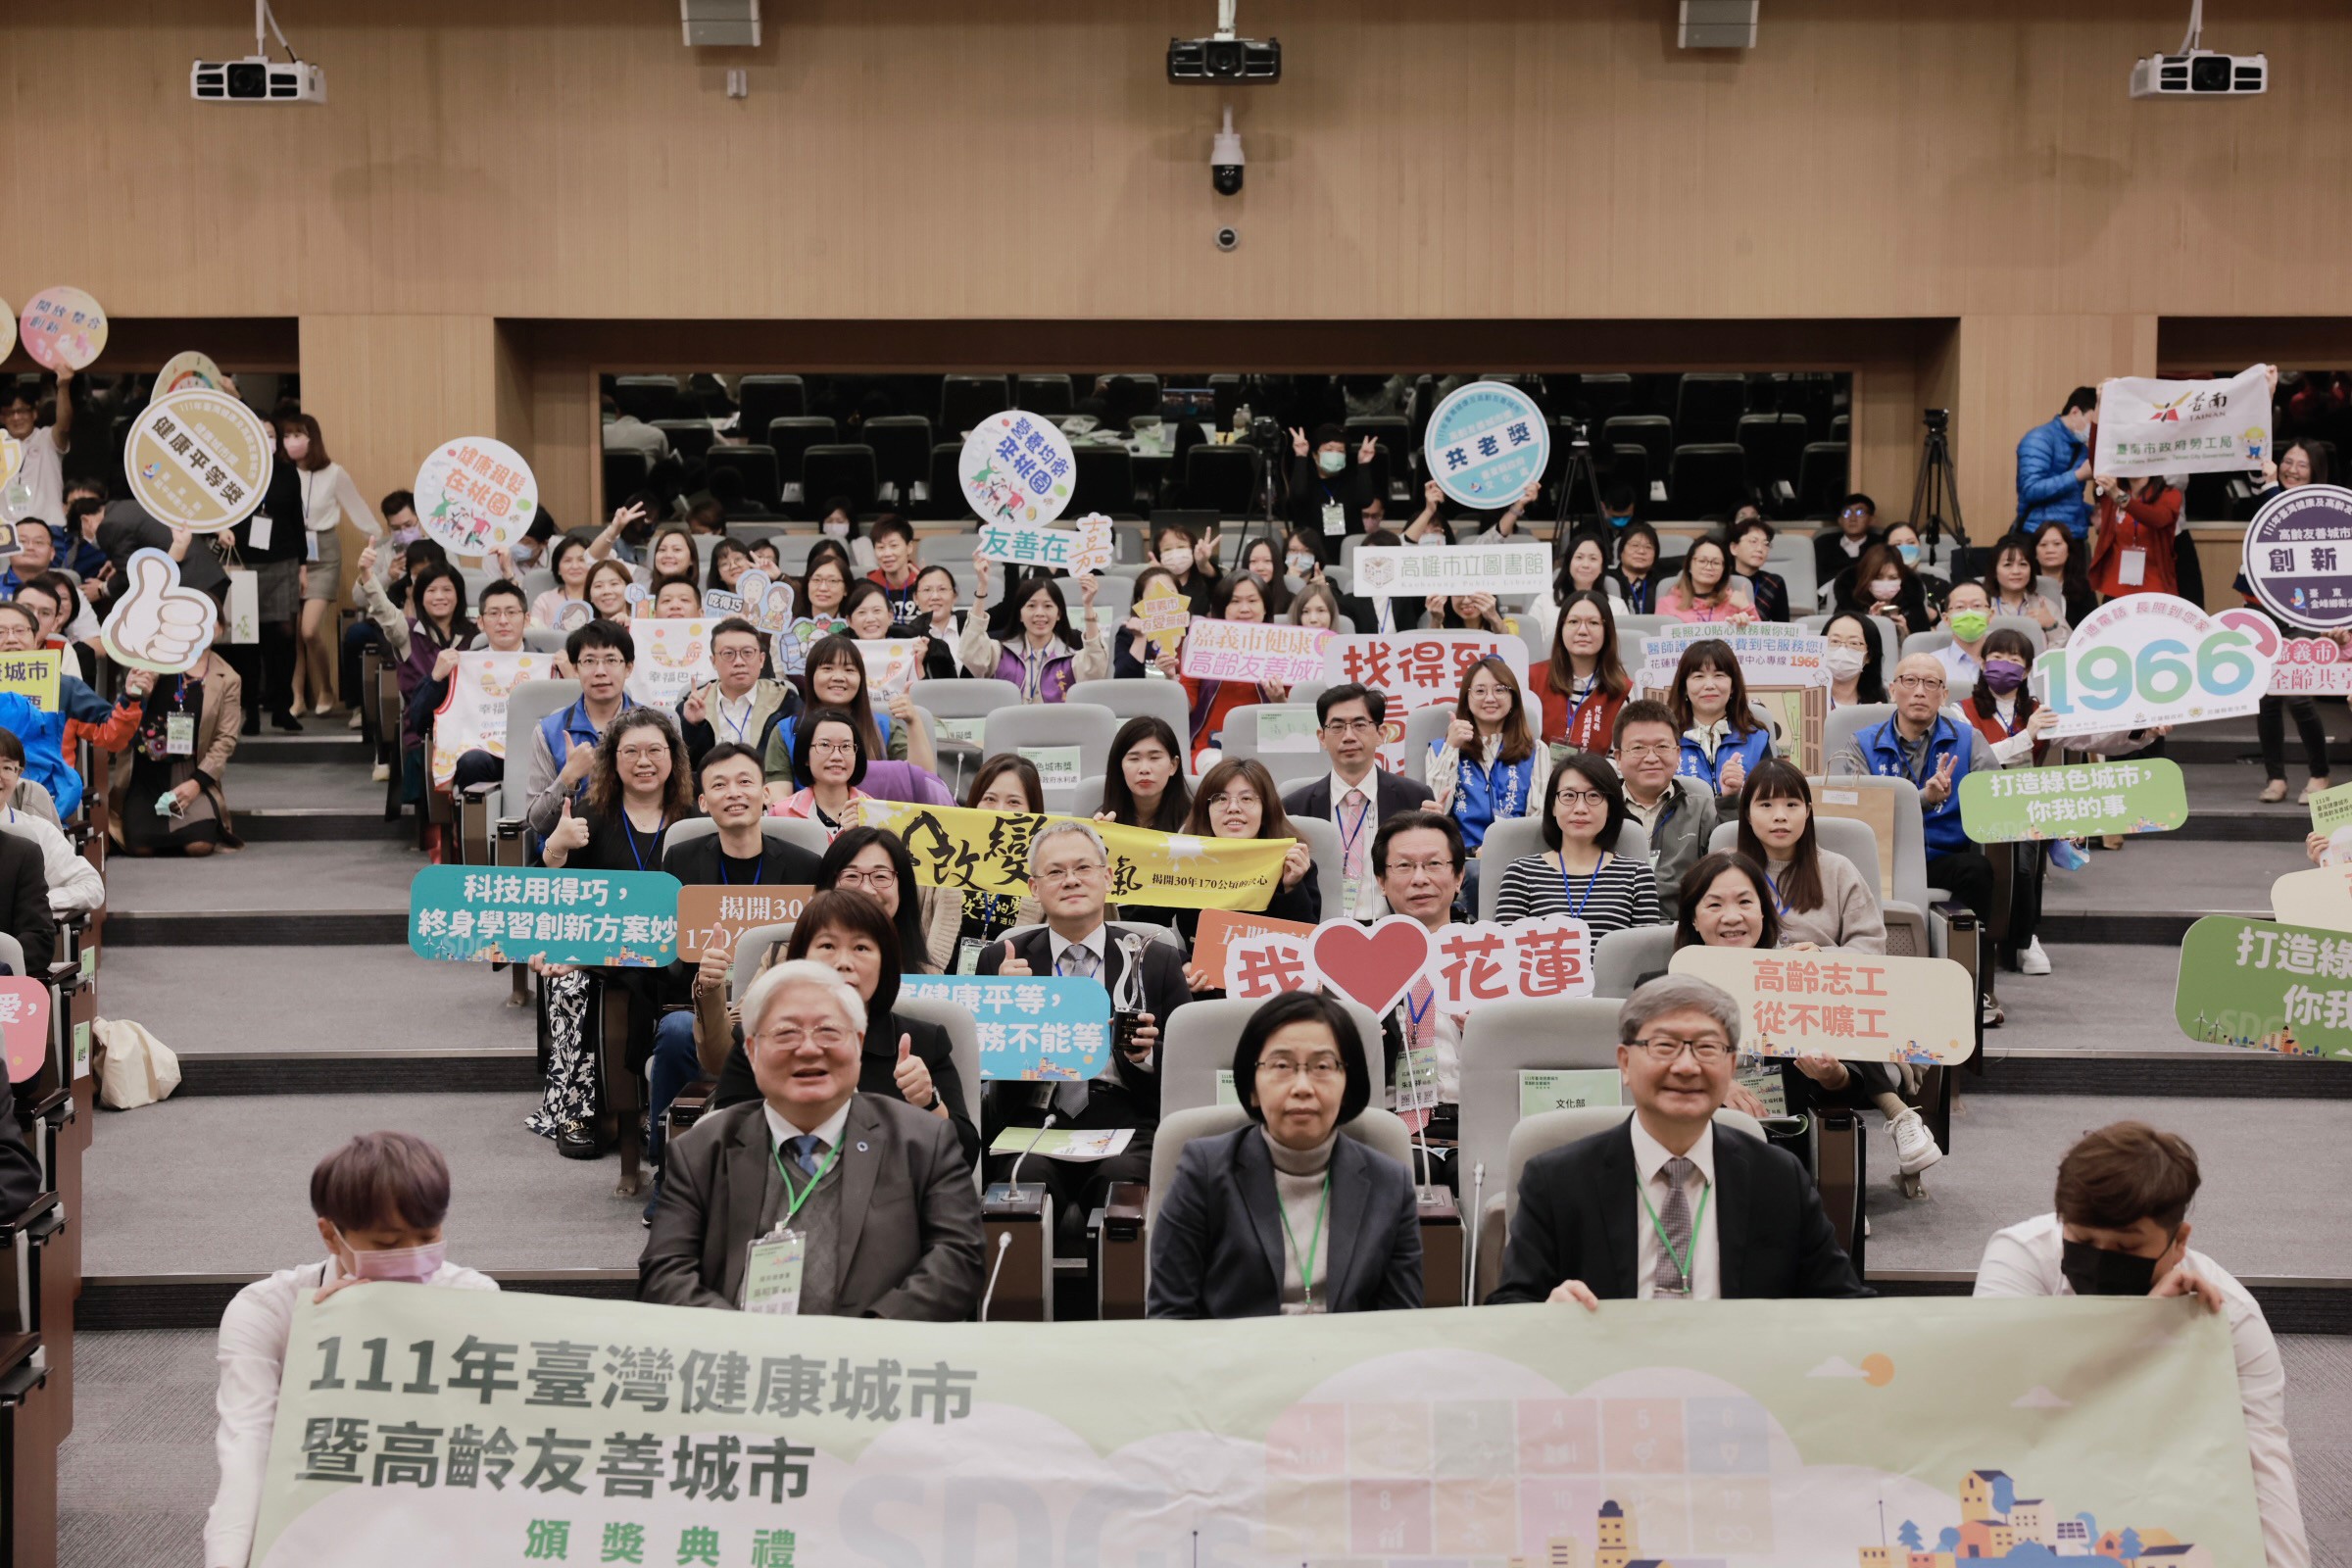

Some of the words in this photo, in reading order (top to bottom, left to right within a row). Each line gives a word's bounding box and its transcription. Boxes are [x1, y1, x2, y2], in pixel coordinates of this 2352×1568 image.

[2189, 411, 2226, 421] TAINAN
[151, 416, 245, 506] 健康平等獎
[1011, 416, 1069, 478] 營養均衡
[1446, 421, 1531, 470] 共老獎
[2116, 435, 2232, 456] 臺南市政府勞工局
[458, 445, 526, 496] 健康銀髮
[445, 467, 512, 516] 在桃園
[2278, 526, 2352, 541] 高齡友善城市
[1400, 553, 1544, 577] 高雄市立圖書館
[2268, 547, 2337, 572] 創新
[1401, 579, 1455, 588] Kaohsiung
[1503, 578, 1544, 587] Library
[708, 593, 743, 612] 吃得巧
[1146, 597, 1179, 614] 嘉義市
[1671, 624, 1799, 639] 長照2.0貼心服務報你知!
[2076, 606, 2129, 647] 一通電話
[2135, 601, 2211, 632] 長照到您家
[1343, 641, 1498, 688] 找得到
[1789, 656, 1820, 668] 1966
[2279, 644, 2332, 662] 嘉義市
[0, 660, 48, 681] 城市
[2036, 630, 2255, 715] 1966
[478, 699, 510, 715] 幸福
[1036, 760, 1073, 772] 色城市獎
[1039, 775, 1078, 784] 政府水利處
[1990, 763, 2152, 798] 打造綠色城市，
[2027, 793, 2128, 823] 你我的事
[464, 873, 628, 906] 科技用得巧，
[718, 896, 815, 921] 揭開30
[417, 907, 678, 944] 終身學習創新方案妙
[1237, 944, 1305, 998] 我
[1440, 926, 1585, 1002] 花蓮
[2235, 925, 2352, 980] 打造綠
[1752, 957, 1888, 996] 高齡志工
[1752, 1000, 1889, 1039] 從不曠工
[1556, 1098, 1586, 1109] 文化部
[308, 1335, 978, 1426] 111年臺灣健康城市
[294, 1415, 815, 1505] 暨高齡友善城市
[524, 1518, 797, 1568] 頒獎典禮
